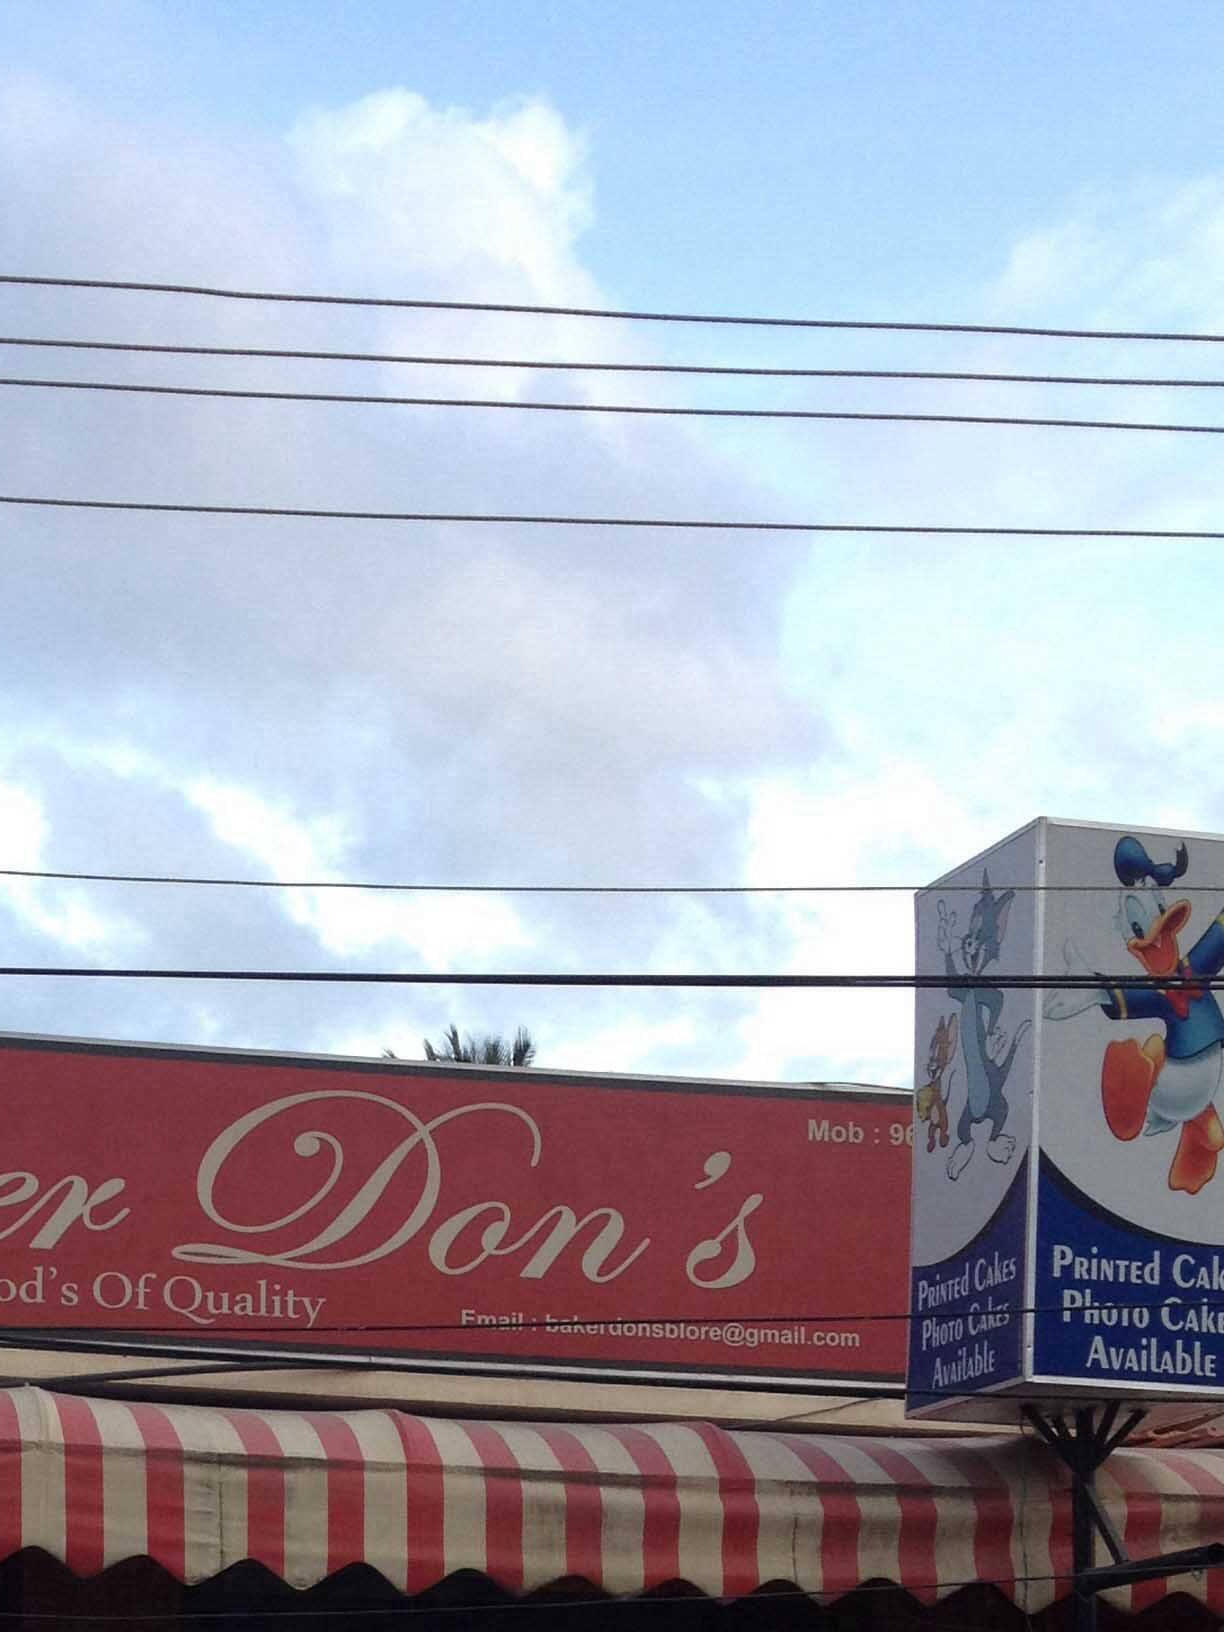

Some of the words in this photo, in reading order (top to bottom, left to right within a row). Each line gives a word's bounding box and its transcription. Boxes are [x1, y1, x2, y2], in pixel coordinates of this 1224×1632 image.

[807, 1119, 864, 1144] Mob
[171, 1089, 764, 1290] Don's
[92, 1271, 155, 1309] Of
[163, 1275, 326, 1329] Quality
[460, 1308, 524, 1331] Email
